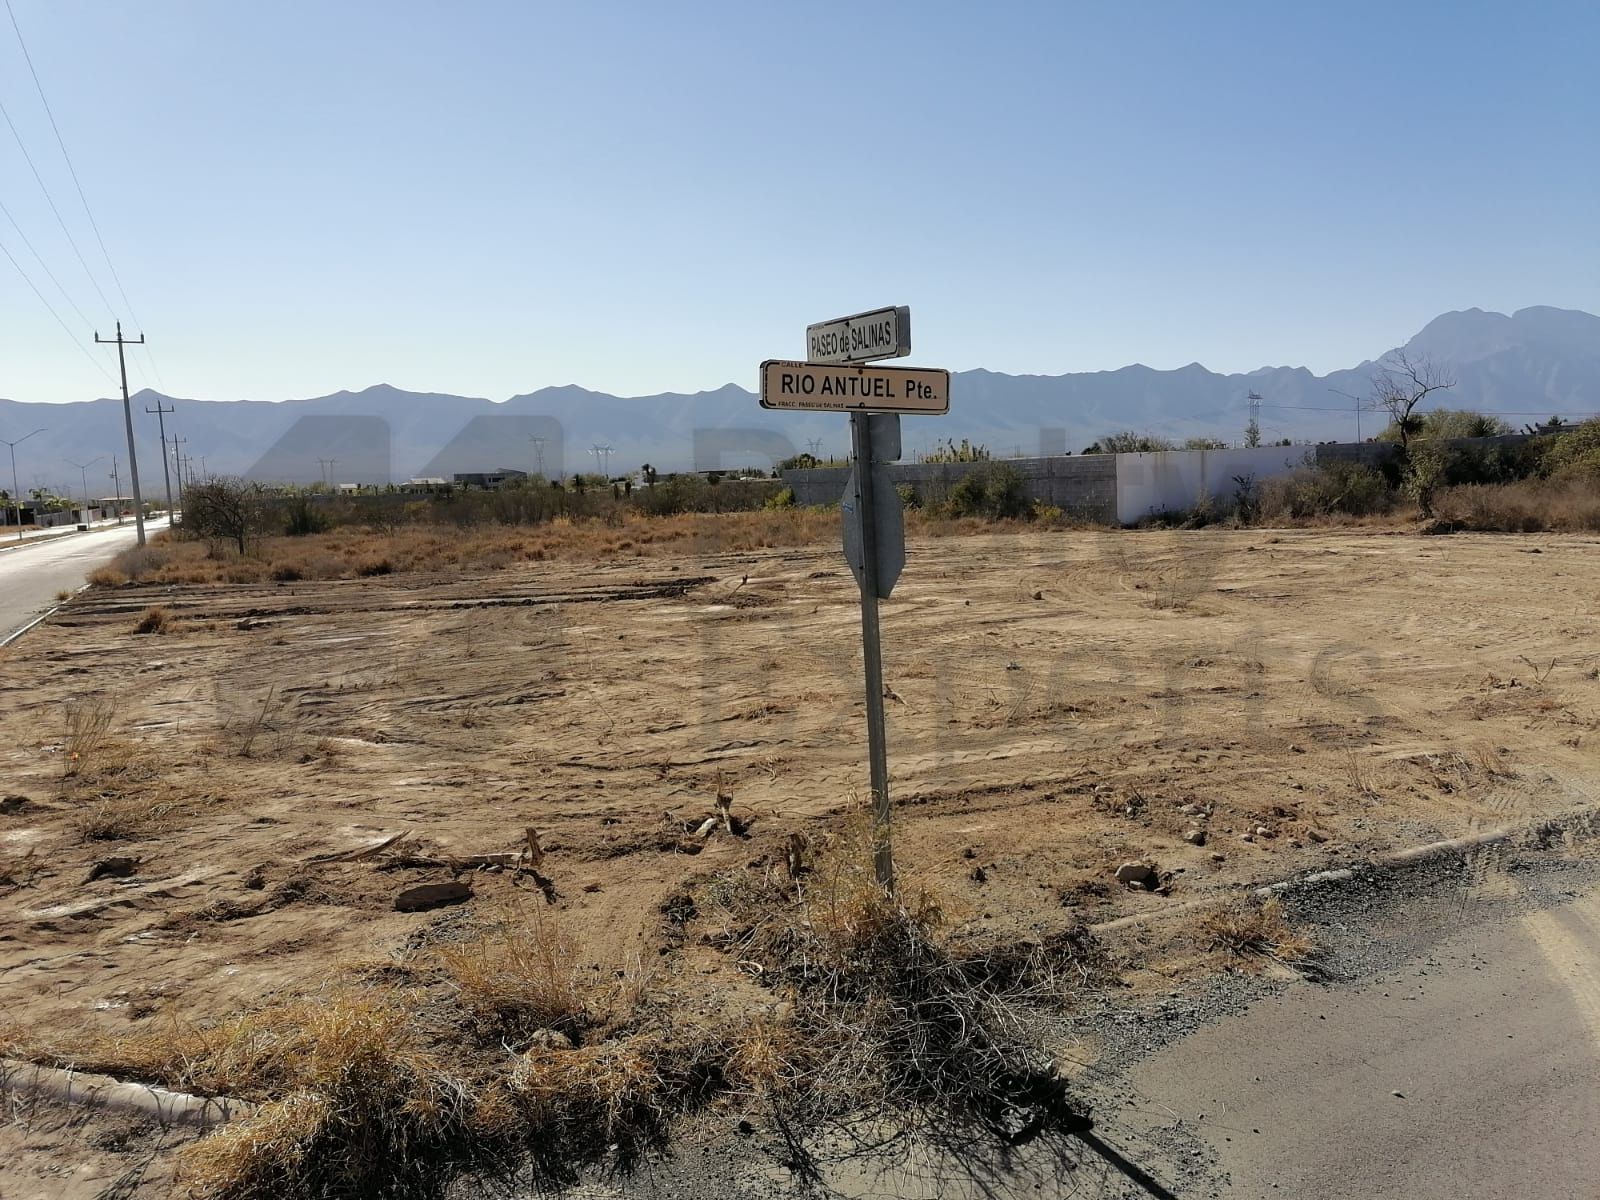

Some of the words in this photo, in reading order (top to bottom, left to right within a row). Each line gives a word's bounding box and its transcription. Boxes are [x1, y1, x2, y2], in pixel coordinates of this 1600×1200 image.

[811, 332, 838, 358] PASEO
[839, 330, 850, 352] de
[851, 321, 891, 351] SALINAS
[782, 374, 815, 395] RIO
[820, 375, 895, 398] ANTUEL
[905, 379, 937, 399] Pte.
